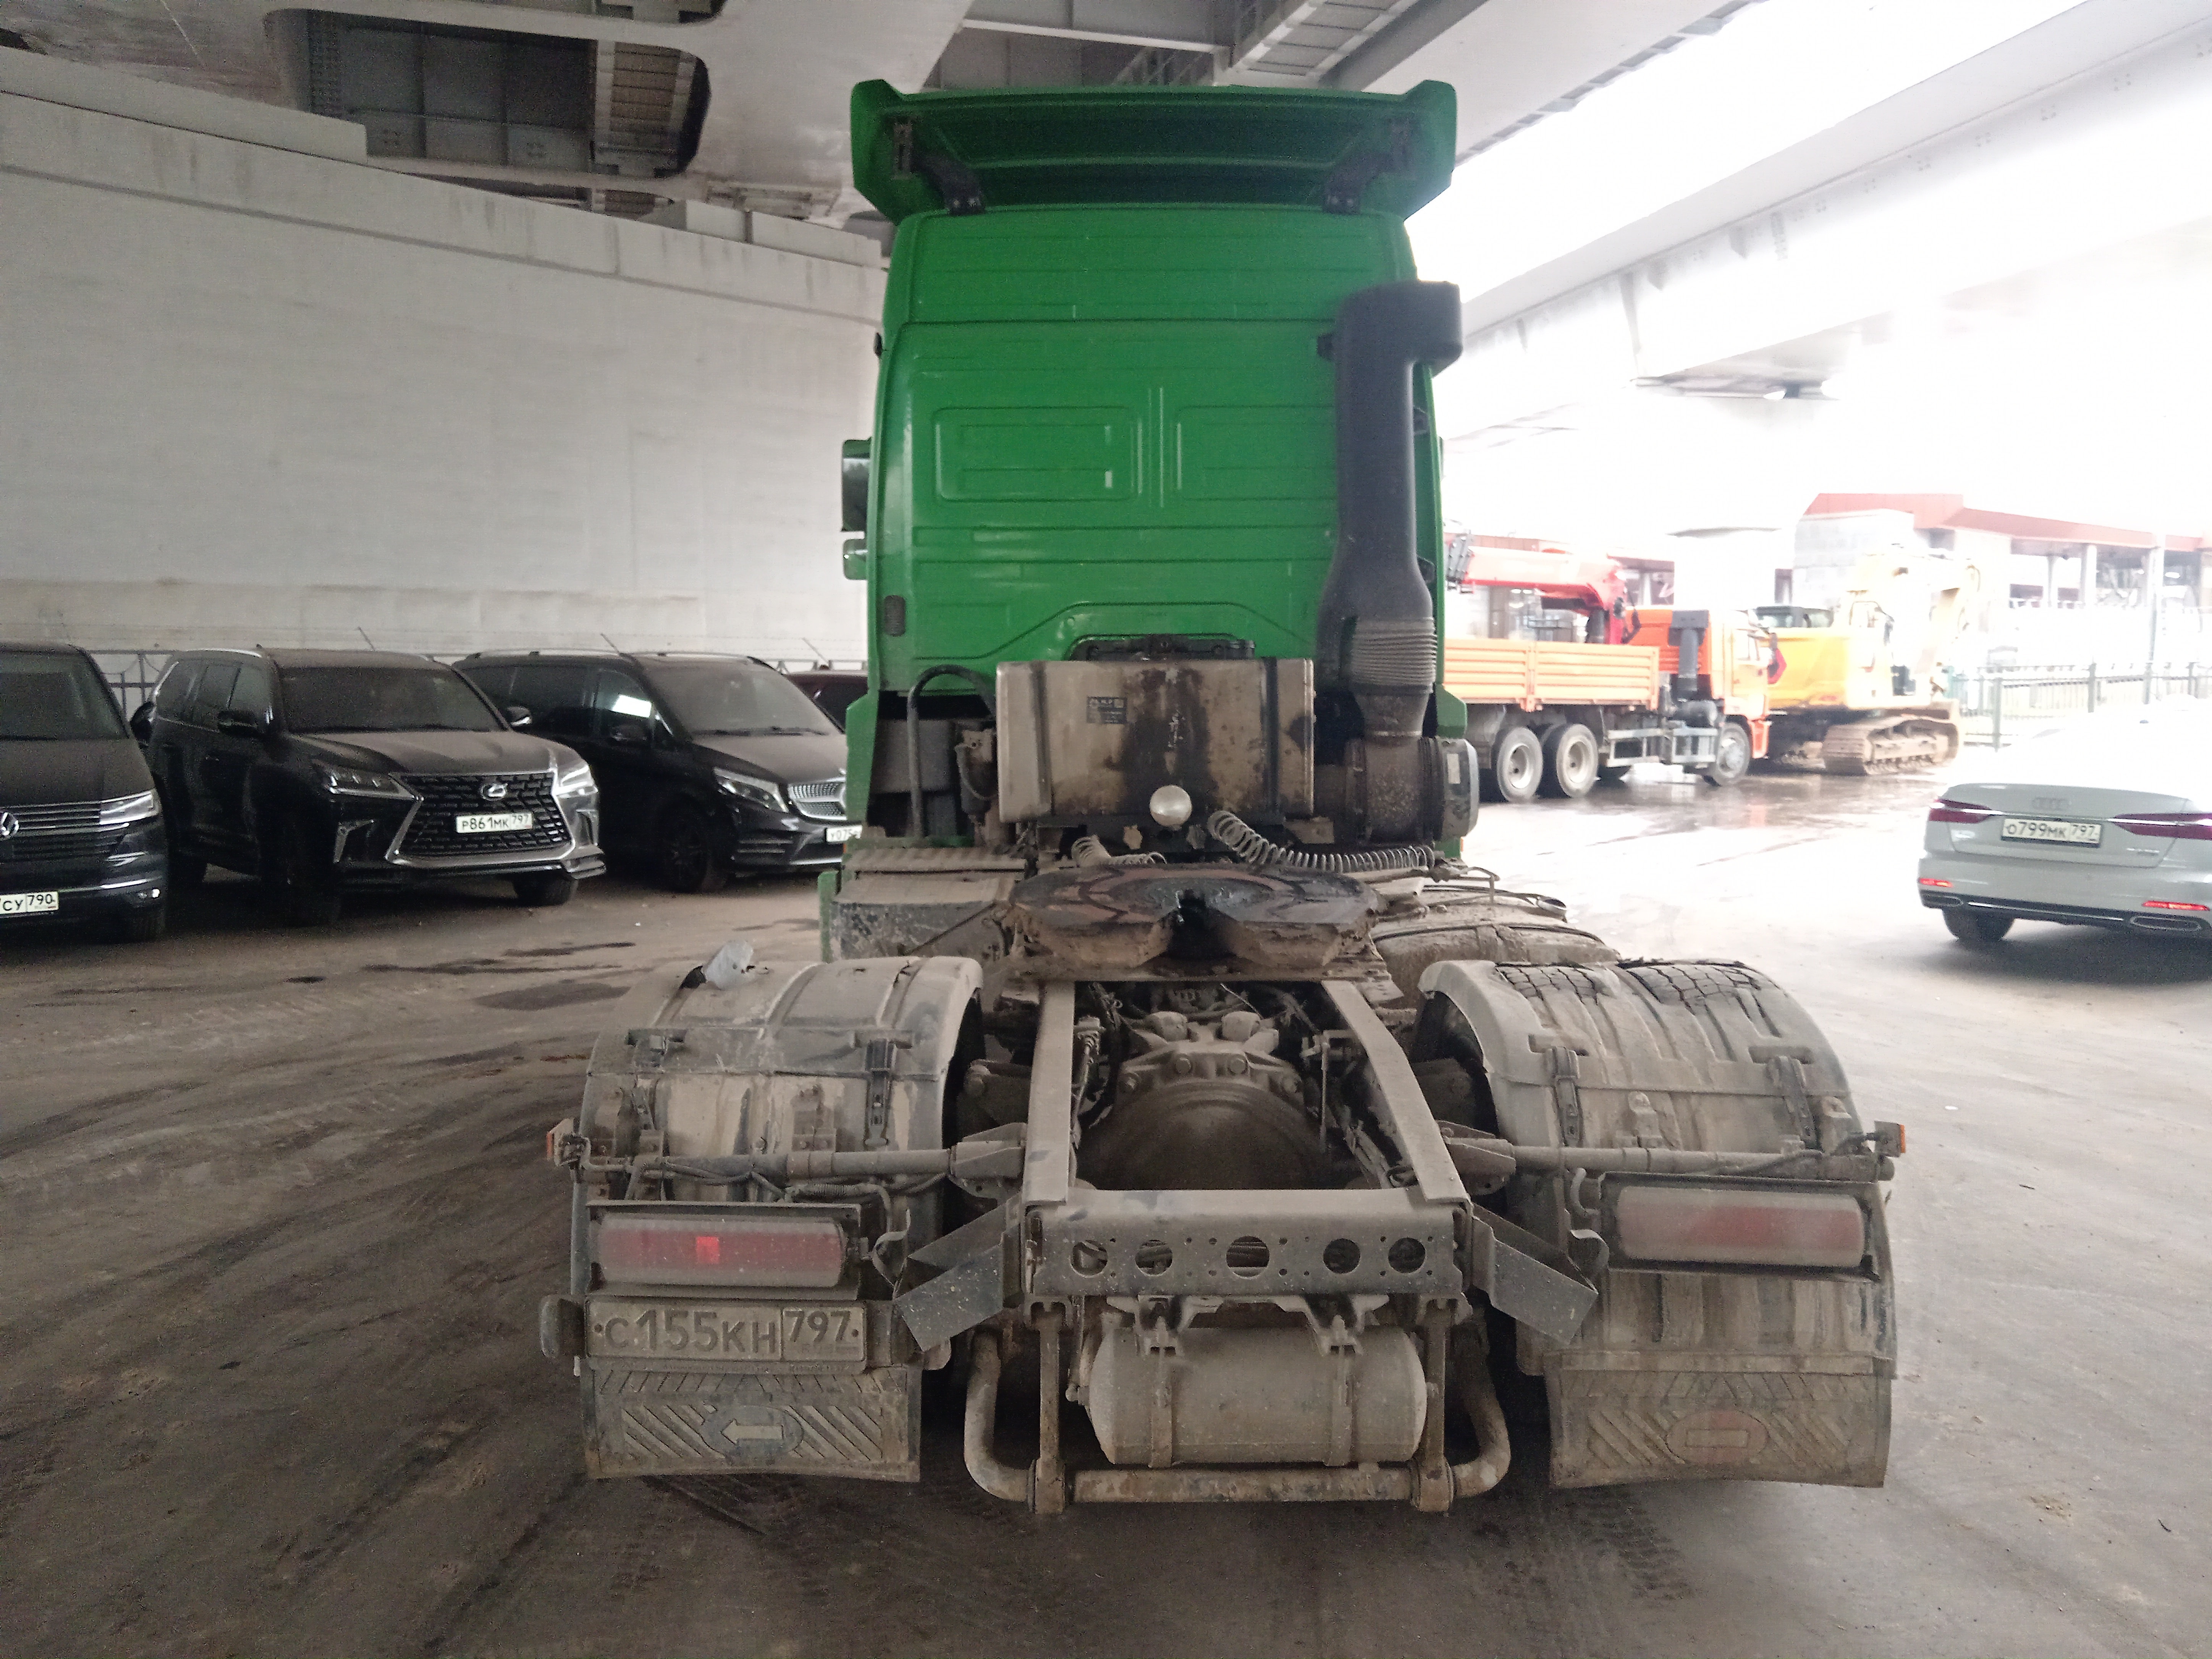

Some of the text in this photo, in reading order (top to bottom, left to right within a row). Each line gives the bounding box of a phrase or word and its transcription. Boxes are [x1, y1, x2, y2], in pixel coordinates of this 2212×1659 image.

[462, 813, 529, 830] Р861МК 797
[27, 894, 52, 905] 790
[605, 1309, 851, 1353] С155КН 797
